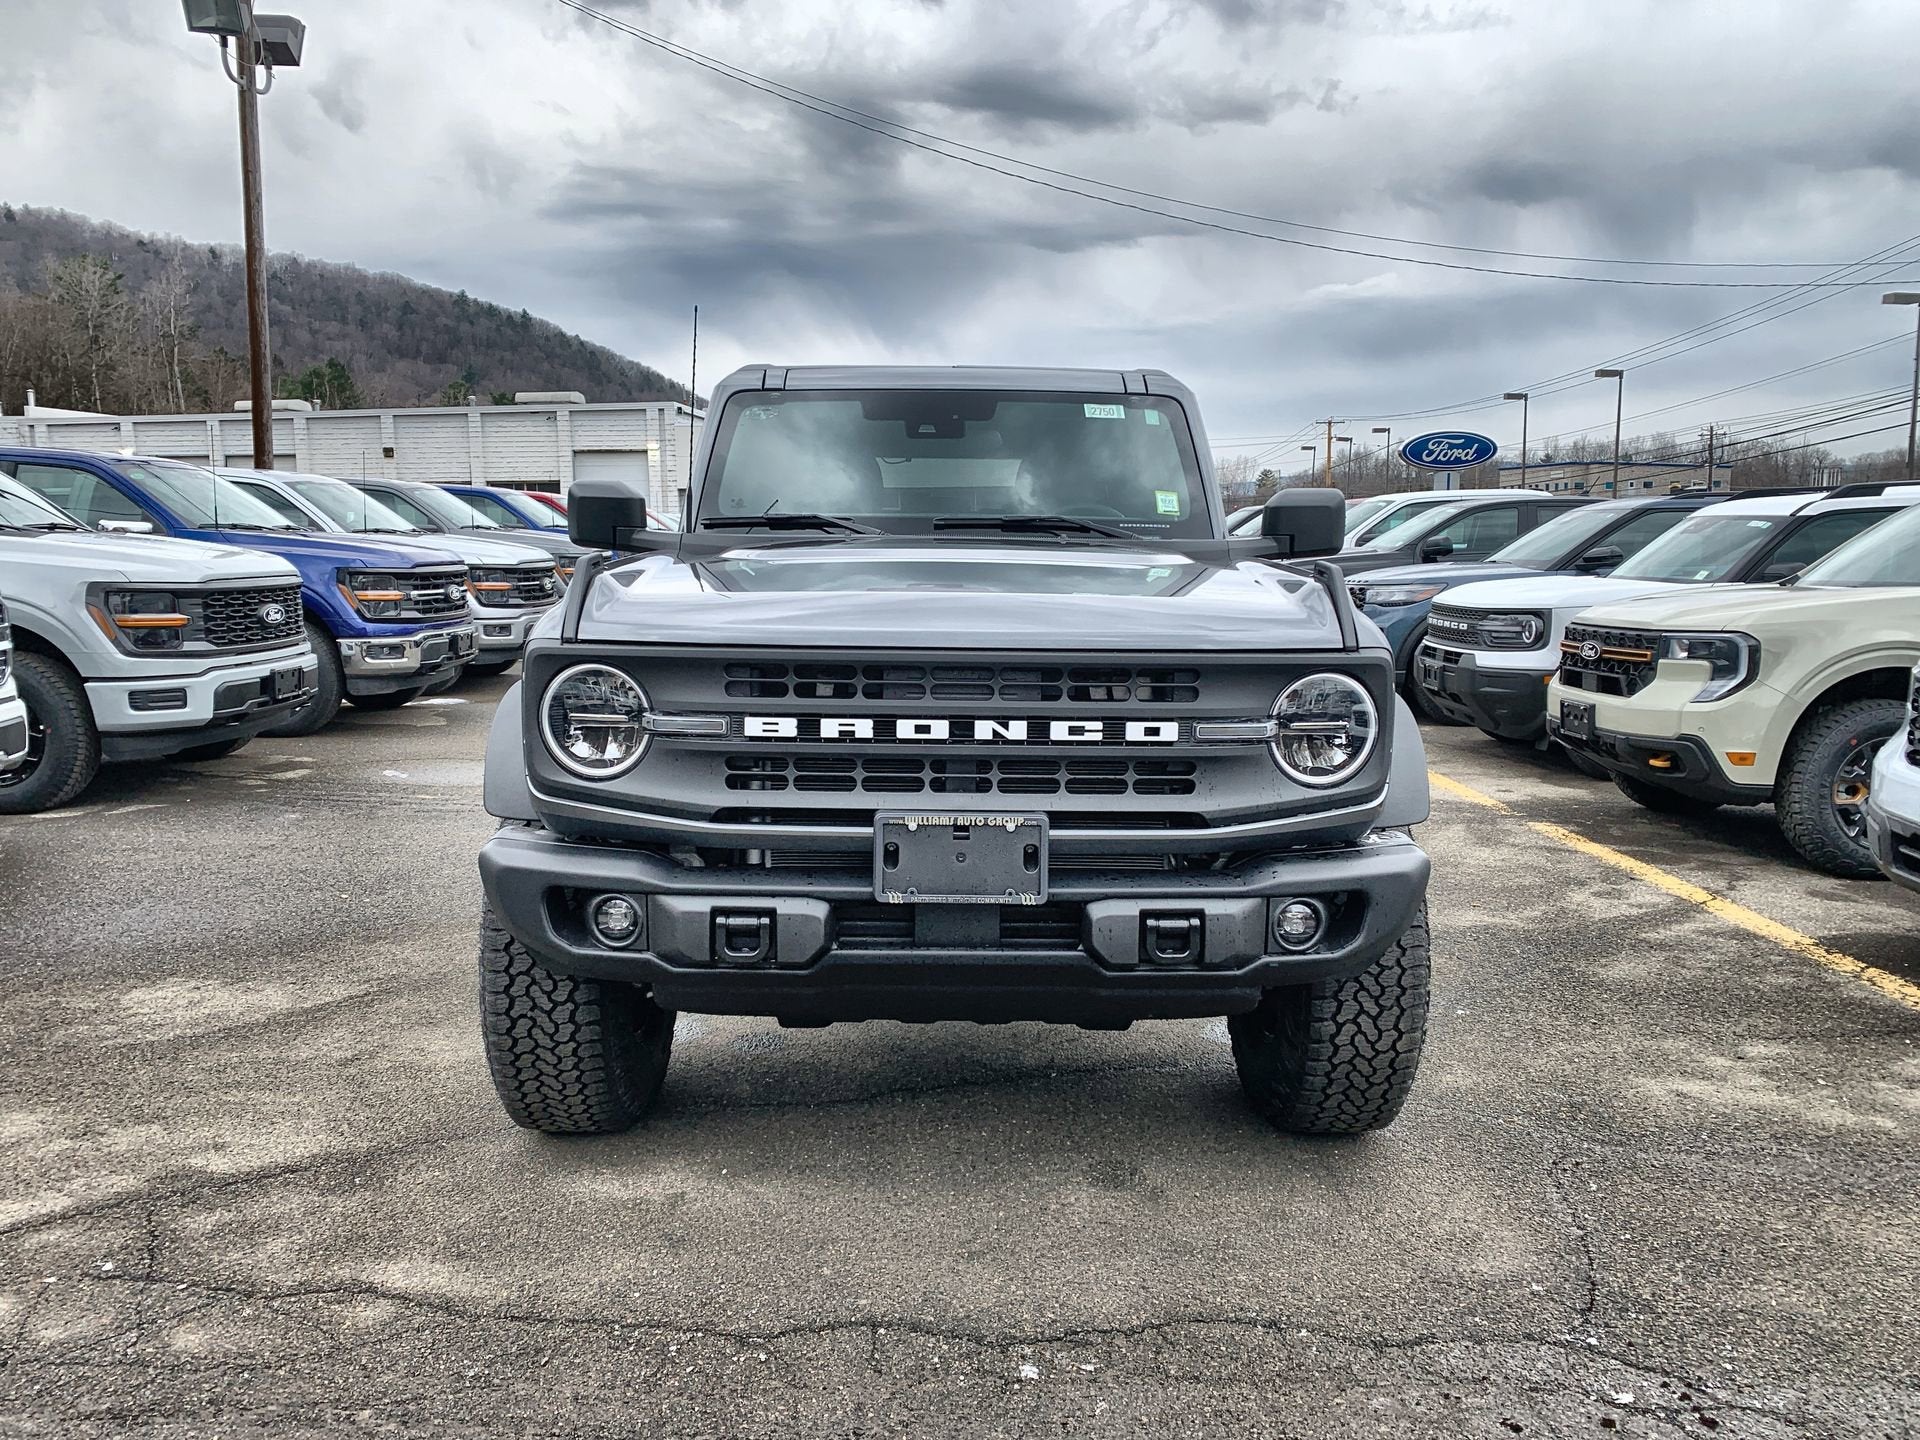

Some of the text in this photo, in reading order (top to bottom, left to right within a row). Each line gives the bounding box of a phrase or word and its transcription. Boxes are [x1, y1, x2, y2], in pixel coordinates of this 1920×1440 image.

[1091, 406, 1115, 417] 2750
[1422, 438, 1479, 462] Ford
[267, 608, 282, 621] Ford
[1428, 617, 1468, 630] BRONCO
[743, 716, 1180, 742] BRONCO
[957, 816, 985, 827] AUTO
